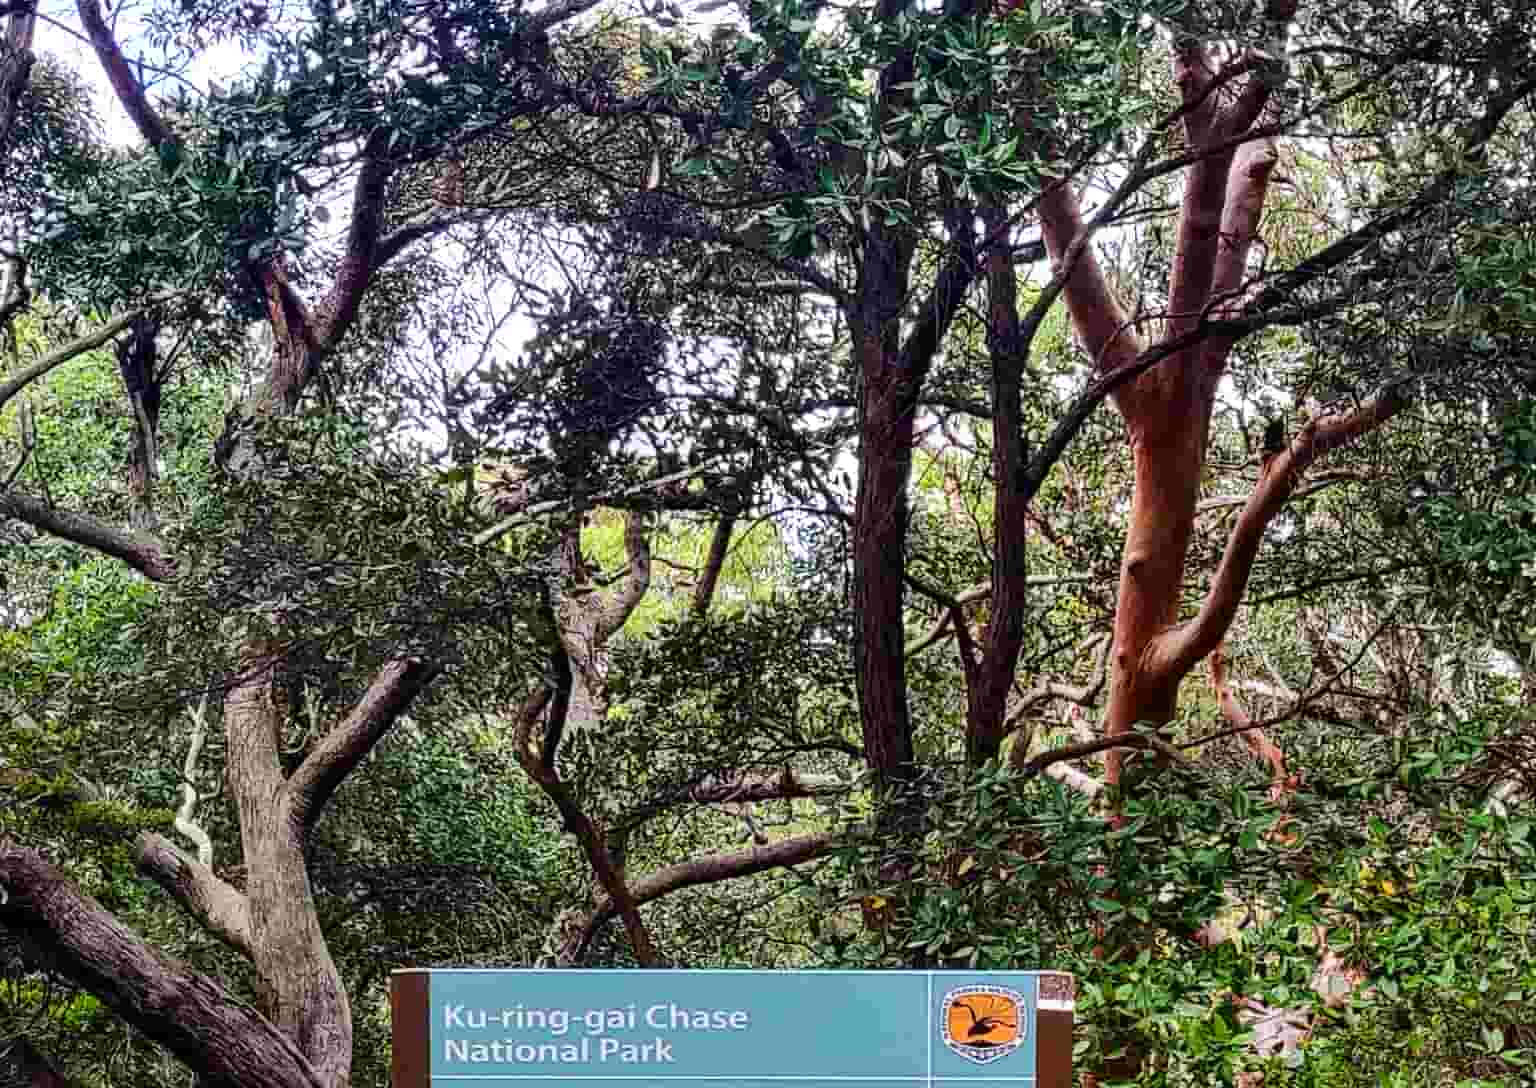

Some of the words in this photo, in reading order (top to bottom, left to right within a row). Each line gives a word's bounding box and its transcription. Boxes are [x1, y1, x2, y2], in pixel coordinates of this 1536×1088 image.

[443, 1002, 636, 1034] Ku-ring-gai
[645, 1001, 749, 1029] Chase
[444, 1036, 591, 1063] National
[600, 1036, 675, 1063] Park
